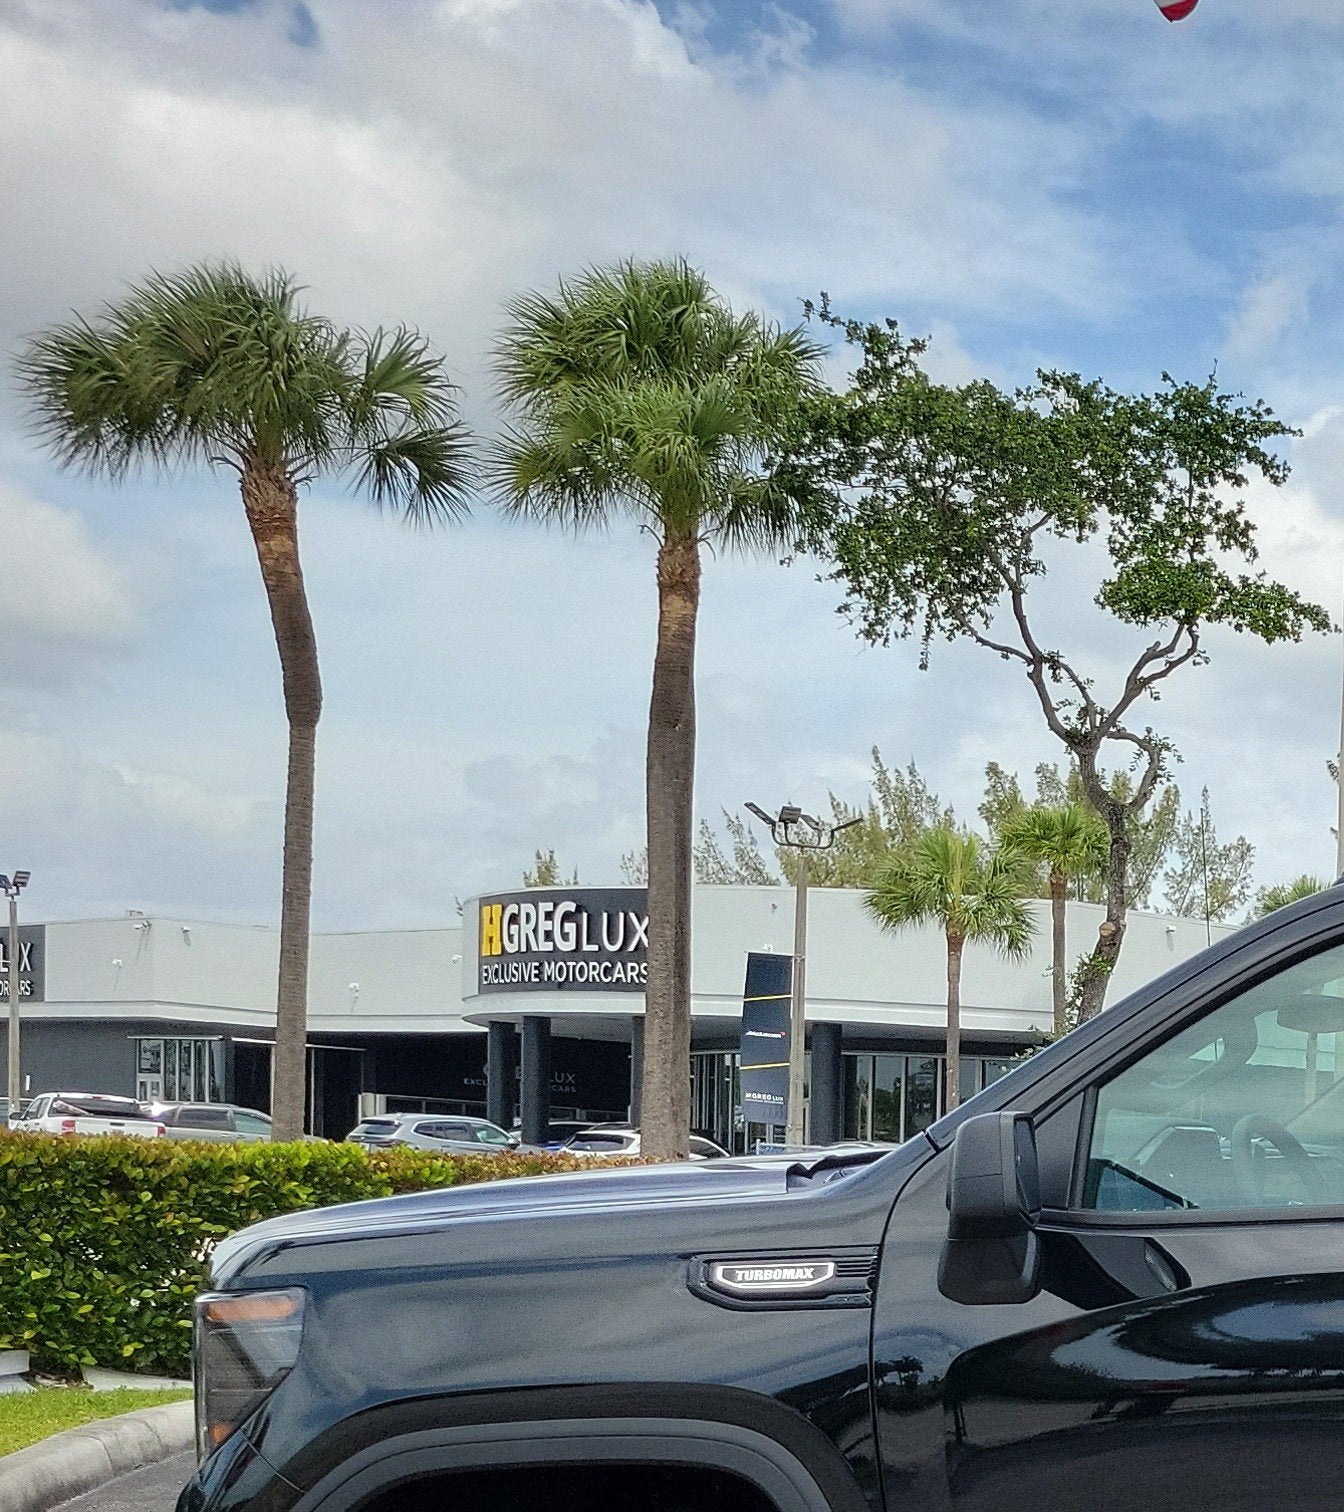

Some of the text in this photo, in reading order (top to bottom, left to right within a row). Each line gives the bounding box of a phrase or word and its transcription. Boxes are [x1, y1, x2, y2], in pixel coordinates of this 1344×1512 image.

[482, 960, 649, 985] EXCLUSIVE MOTORCARS
[735, 1267, 815, 1282] TURBOMAX
